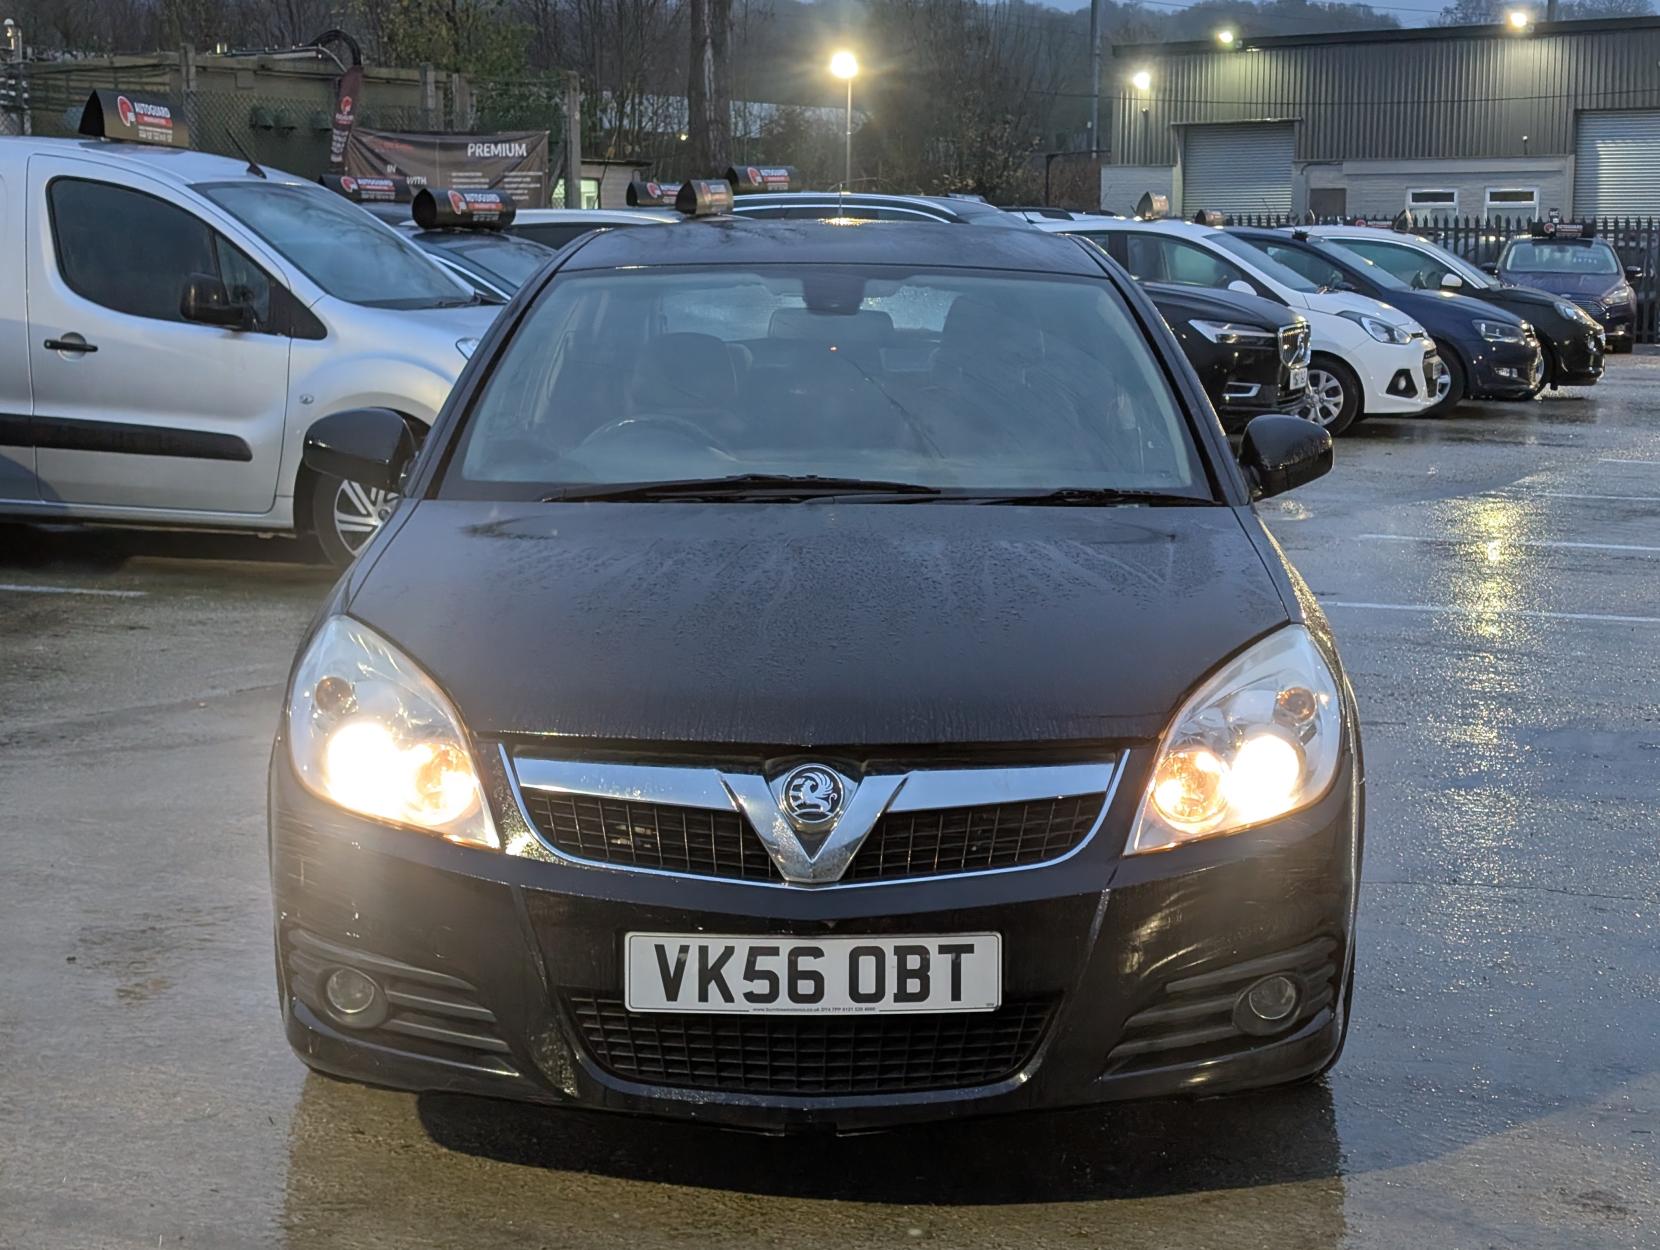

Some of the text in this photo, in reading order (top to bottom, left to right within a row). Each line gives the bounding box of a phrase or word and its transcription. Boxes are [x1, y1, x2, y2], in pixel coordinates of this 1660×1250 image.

[467, 143, 527, 157] PREMIUM
[406, 176, 427, 185] WITH
[654, 944, 975, 1003] VK56 OBT
